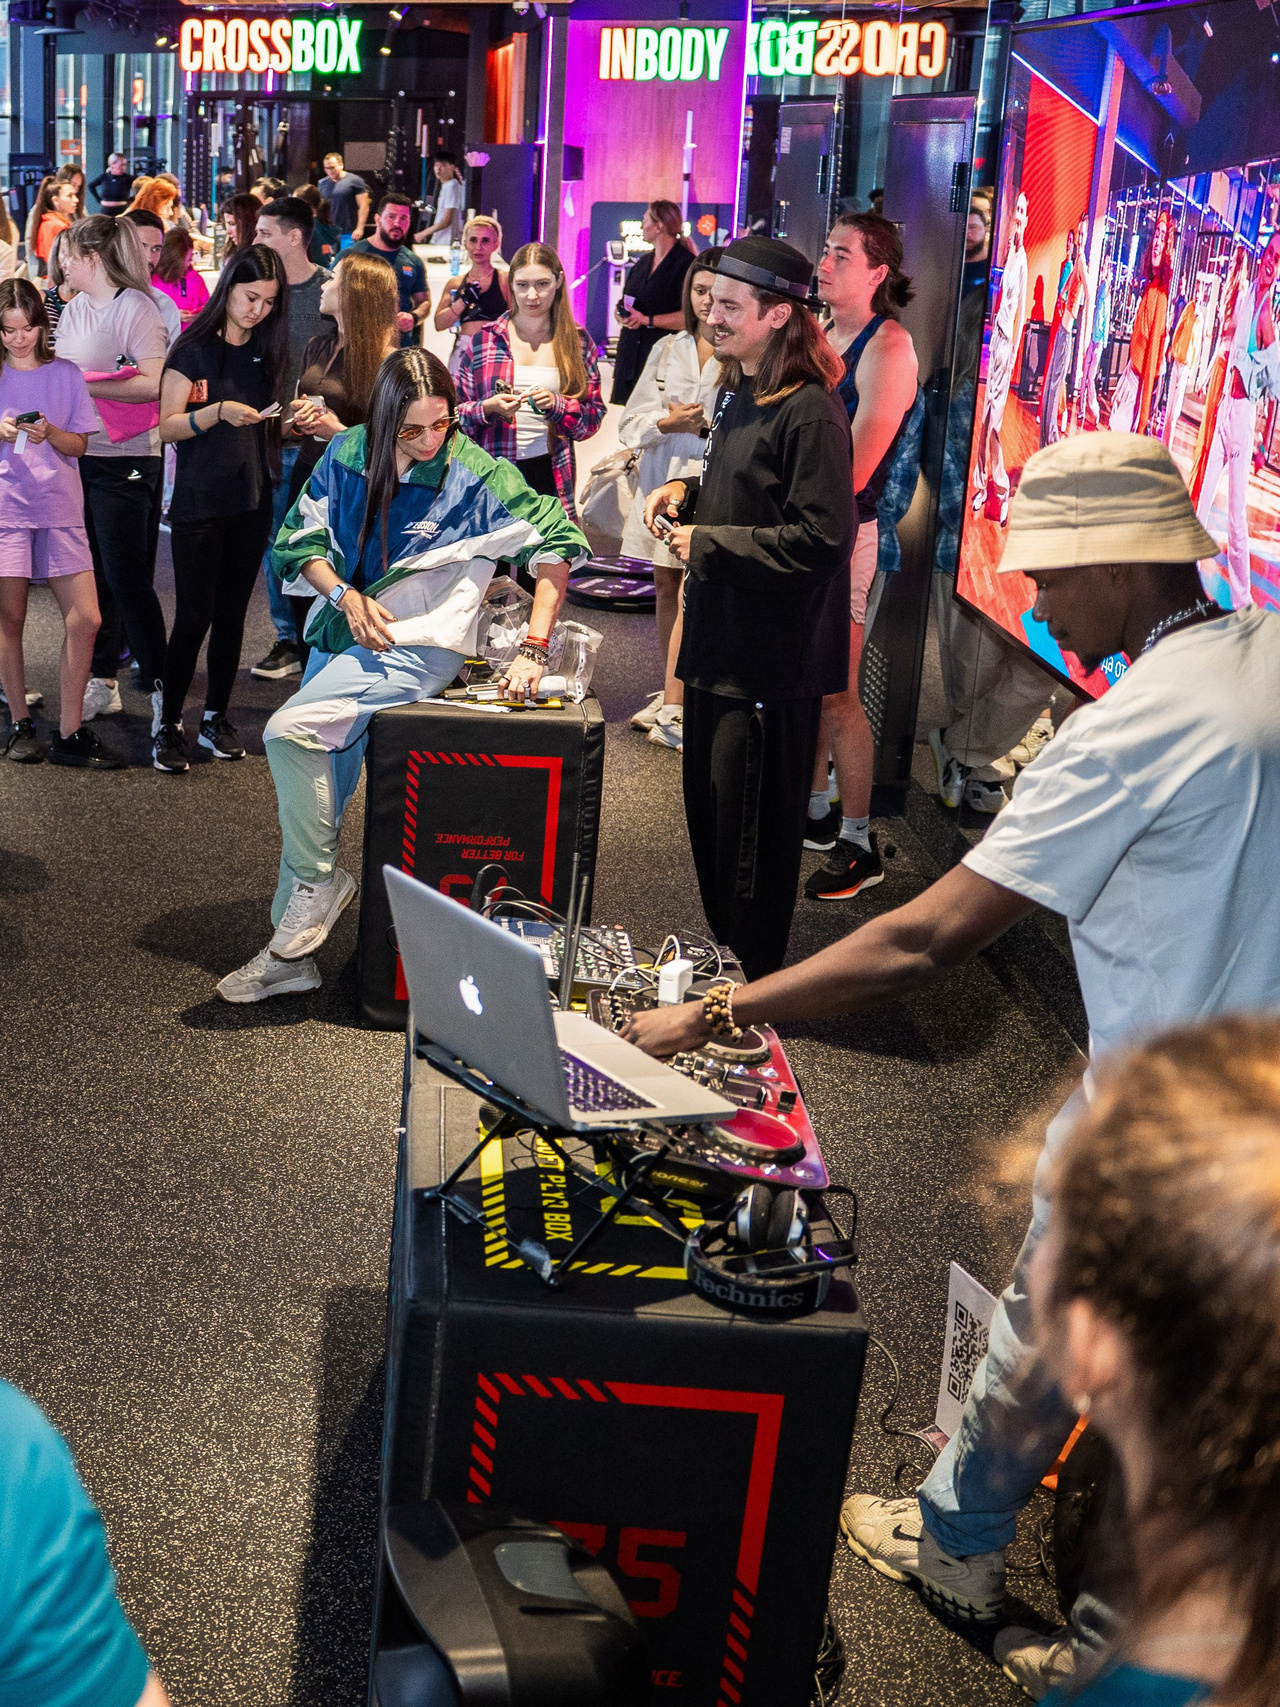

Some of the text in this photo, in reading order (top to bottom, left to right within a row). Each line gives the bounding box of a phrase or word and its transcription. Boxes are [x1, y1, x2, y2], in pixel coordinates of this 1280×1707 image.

[180, 18, 363, 73] CROSSBOX
[599, 27, 730, 81] INBODY
[461, 848, 525, 861] FOR BETTER
[543, 1213, 574, 1242] BOX
[693, 1264, 805, 1308] Technics
